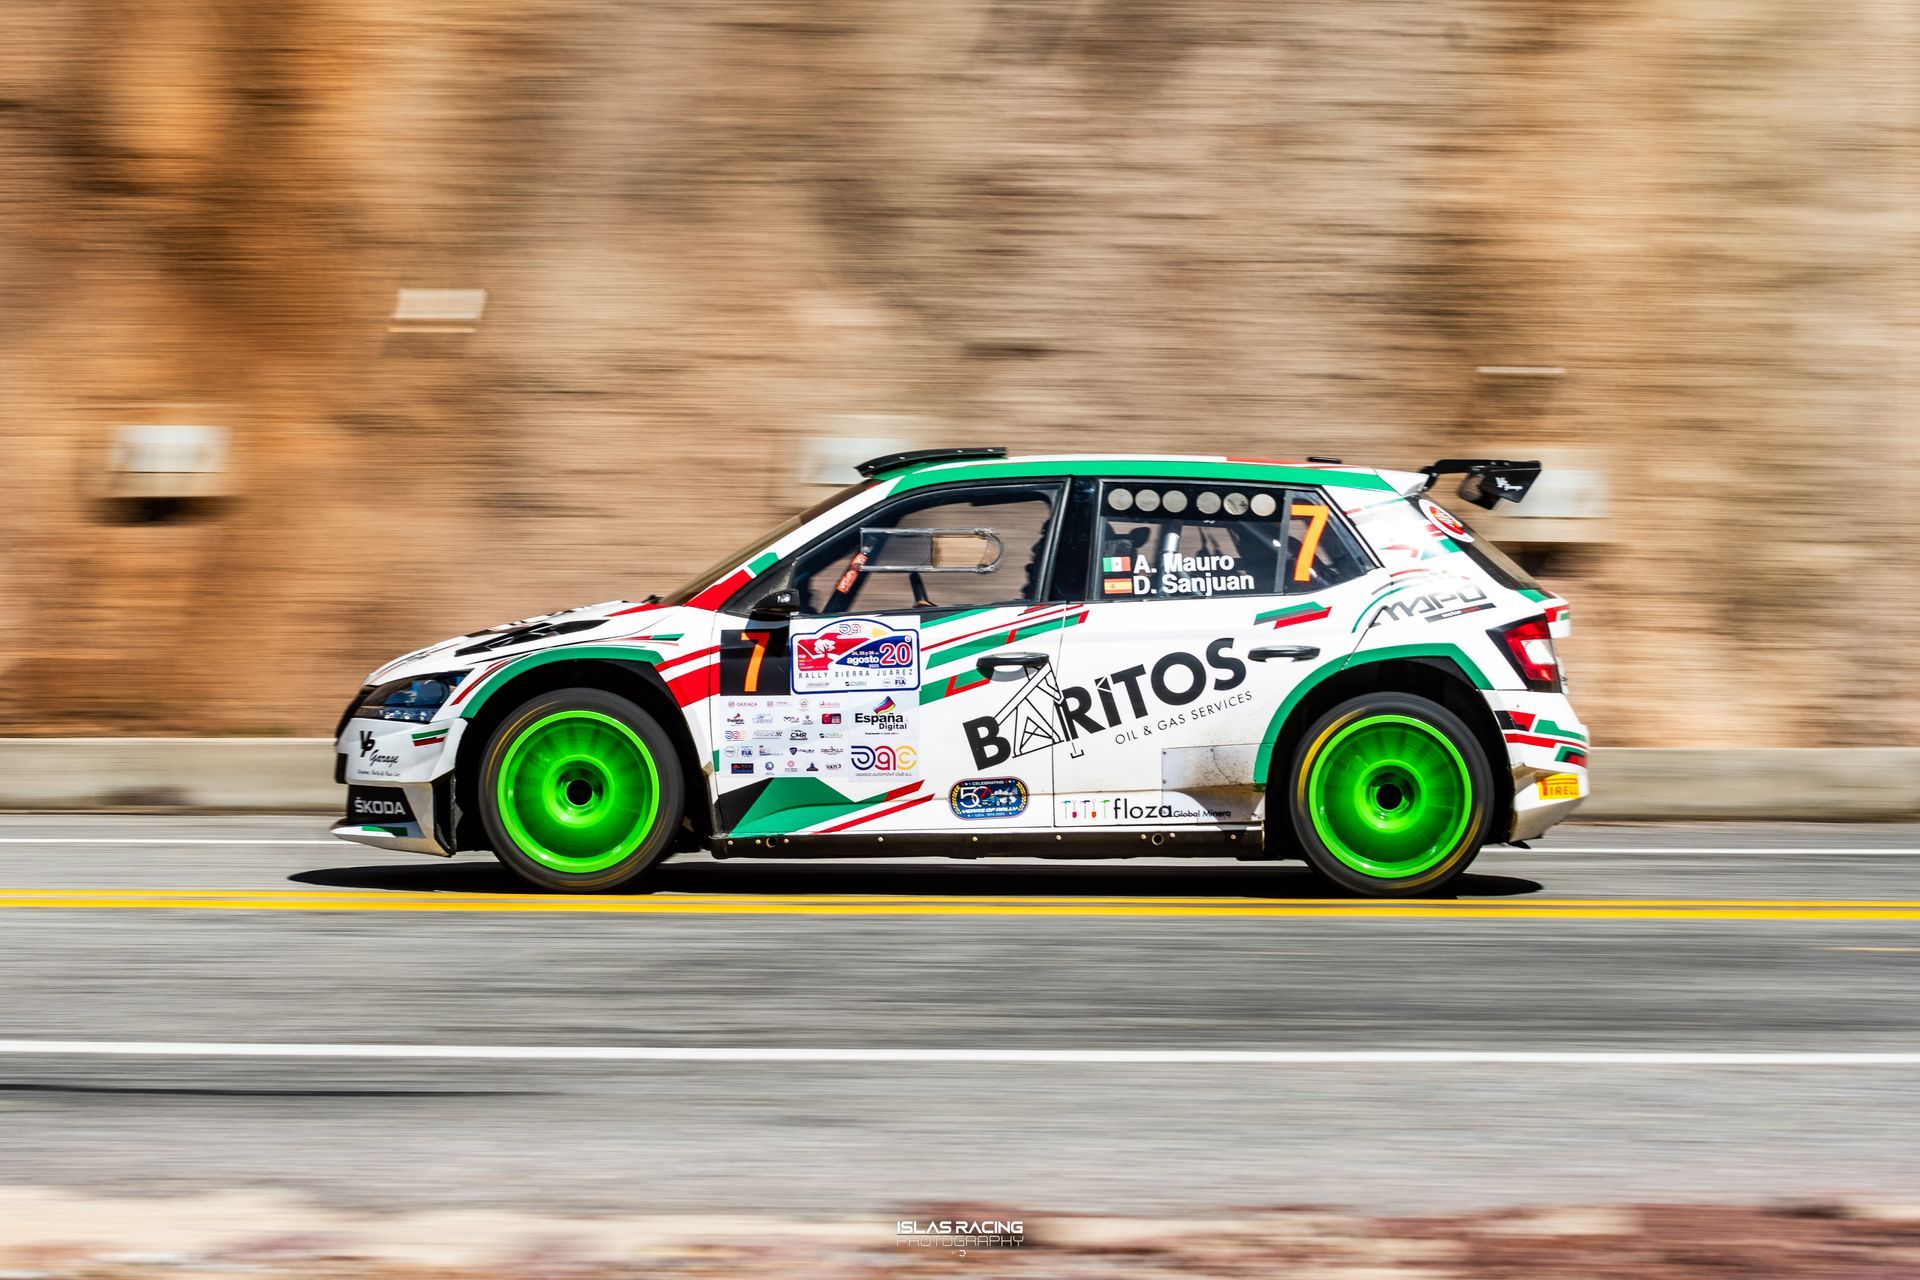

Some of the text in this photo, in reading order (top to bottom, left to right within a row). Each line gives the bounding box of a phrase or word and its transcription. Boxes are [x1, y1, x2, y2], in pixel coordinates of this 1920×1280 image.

[1290, 504, 1329, 582] 7
[1133, 552, 1235, 574] A. Mauro
[1133, 573, 1255, 597] D. Sanjuan
[741, 632, 770, 692] 7
[847, 656, 880, 665] agosto
[879, 643, 912, 666] 20
[799, 671, 829, 679] RALLY
[854, 712, 904, 725] España
[879, 723, 907, 731] Digital
[1115, 690, 1253, 744] OIL & GAS SERVICES
[355, 797, 406, 815] ŠKODA
[1113, 798, 1231, 820] floza Global Minera
